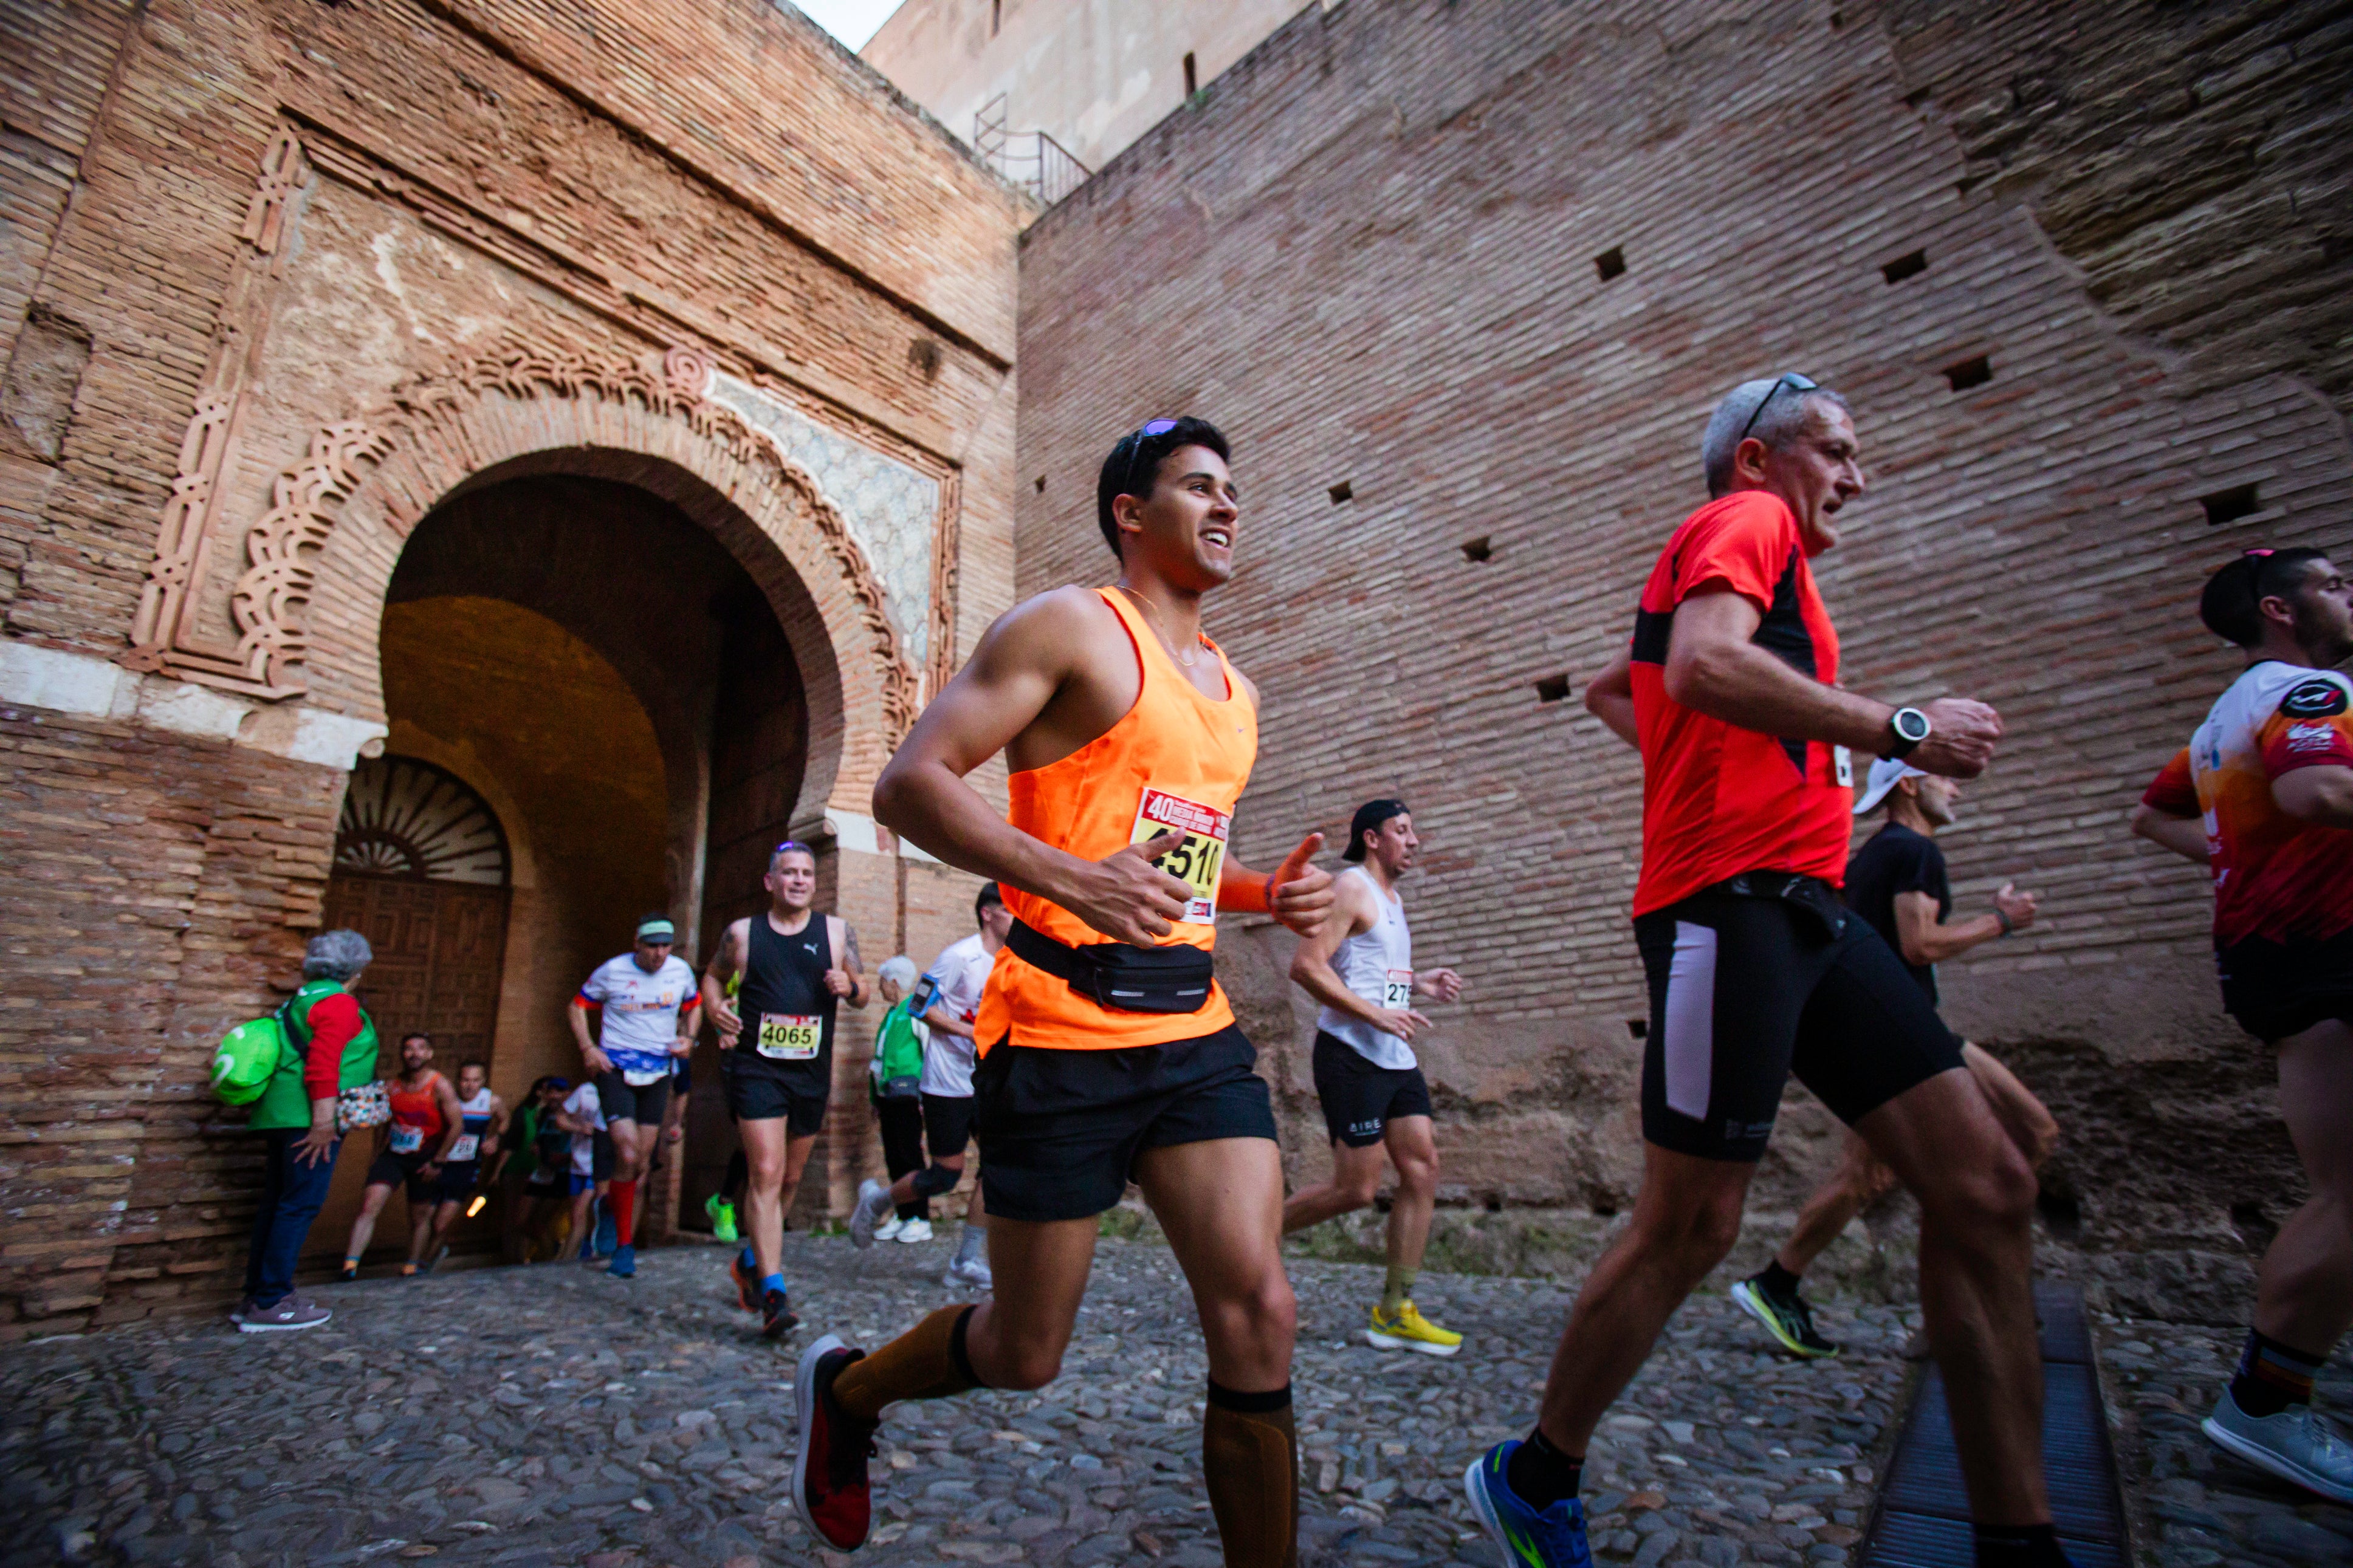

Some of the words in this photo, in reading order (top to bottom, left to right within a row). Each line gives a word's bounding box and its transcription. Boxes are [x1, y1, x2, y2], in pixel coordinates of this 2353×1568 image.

[1148, 795, 1175, 822] 40
[762, 1026, 811, 1044] 4065
[1350, 1117, 1381, 1132] AIRE
